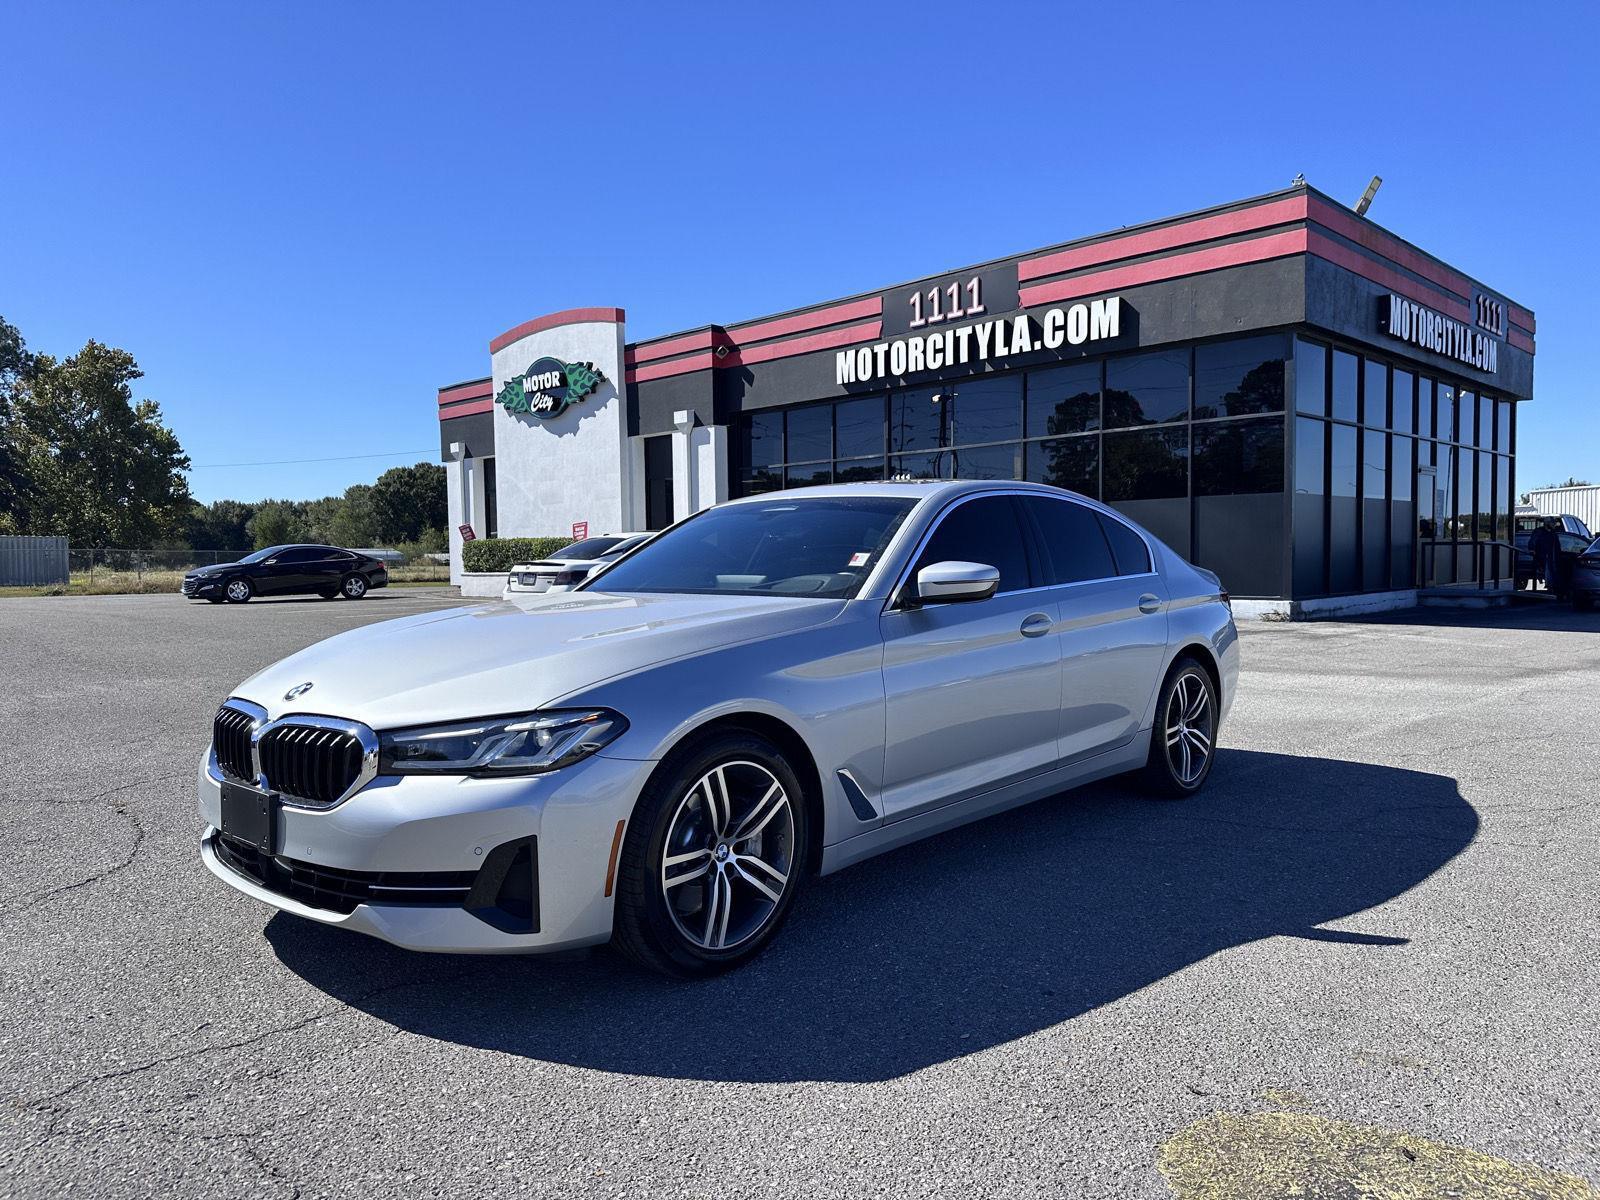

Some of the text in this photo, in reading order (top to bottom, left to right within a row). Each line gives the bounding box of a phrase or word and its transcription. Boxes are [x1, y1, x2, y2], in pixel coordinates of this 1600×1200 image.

[909, 276, 985, 328] 1111
[1478, 294, 1503, 336] 1111
[836, 296, 1121, 385] MOTORCITYLA.COM
[1389, 294, 1497, 373] MOTORCITYLA.COM
[522, 371, 560, 393] MOTOR
[531, 392, 554, 412] City
